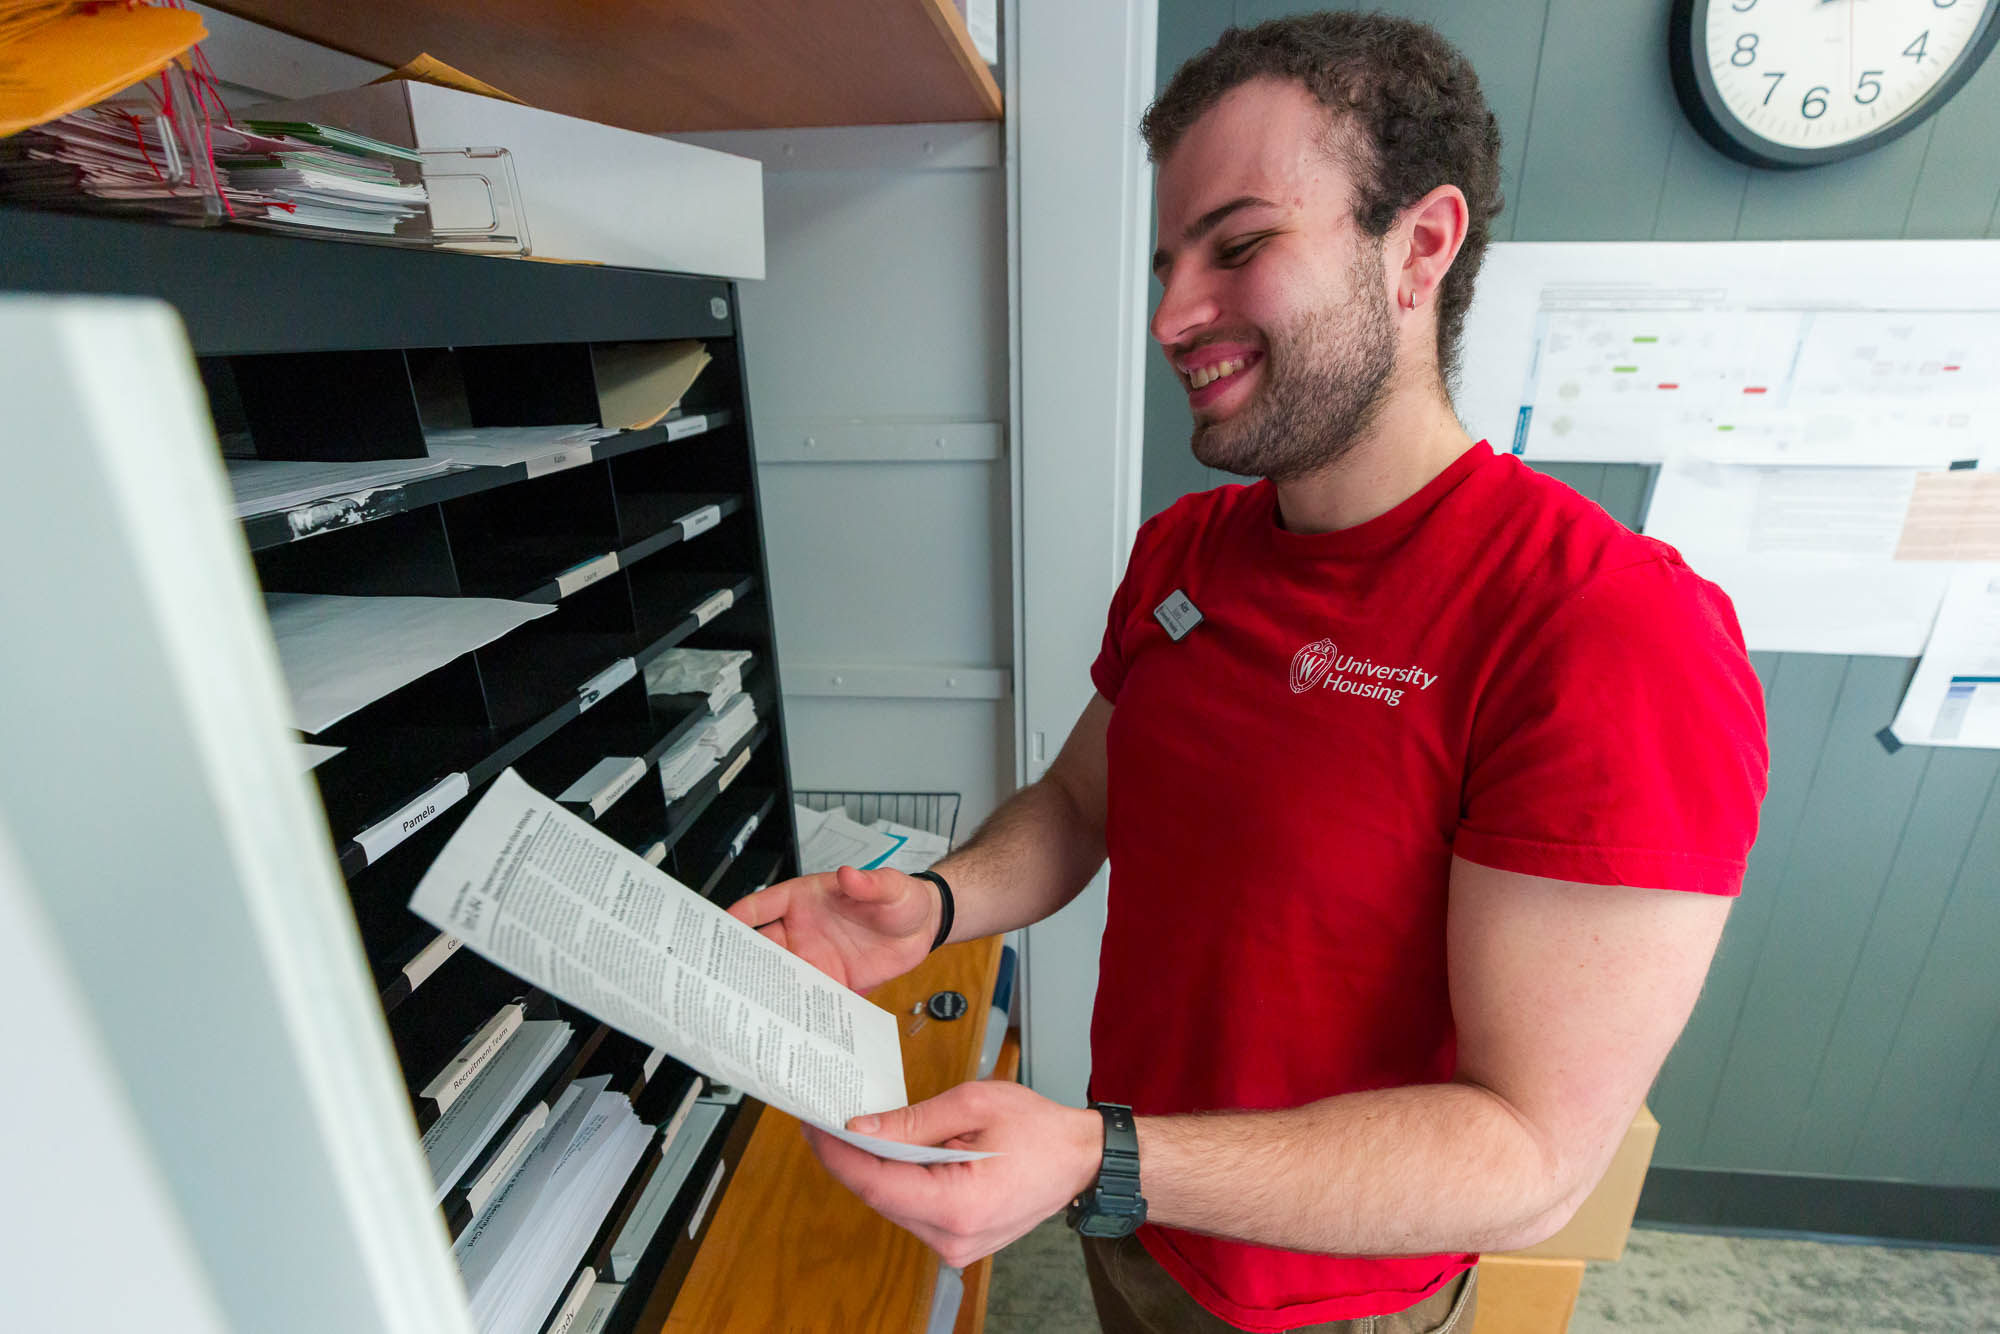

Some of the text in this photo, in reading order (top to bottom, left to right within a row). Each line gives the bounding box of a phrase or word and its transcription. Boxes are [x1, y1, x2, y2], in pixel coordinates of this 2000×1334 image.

[1730, 33, 1760, 67] 8
[1902, 29, 1930, 64] 4
[1762, 72, 1787, 106] 7
[1801, 86, 1830, 119] 6
[1853, 71, 1885, 104] 5
[1322, 672, 1405, 706] Housing
[1335, 655, 1438, 690] University
[402, 804, 436, 833] Pamela
[453, 1026, 509, 1091] Recruitment Team
[479, 1202, 503, 1231] Security
[466, 1230, 483, 1248] Card
